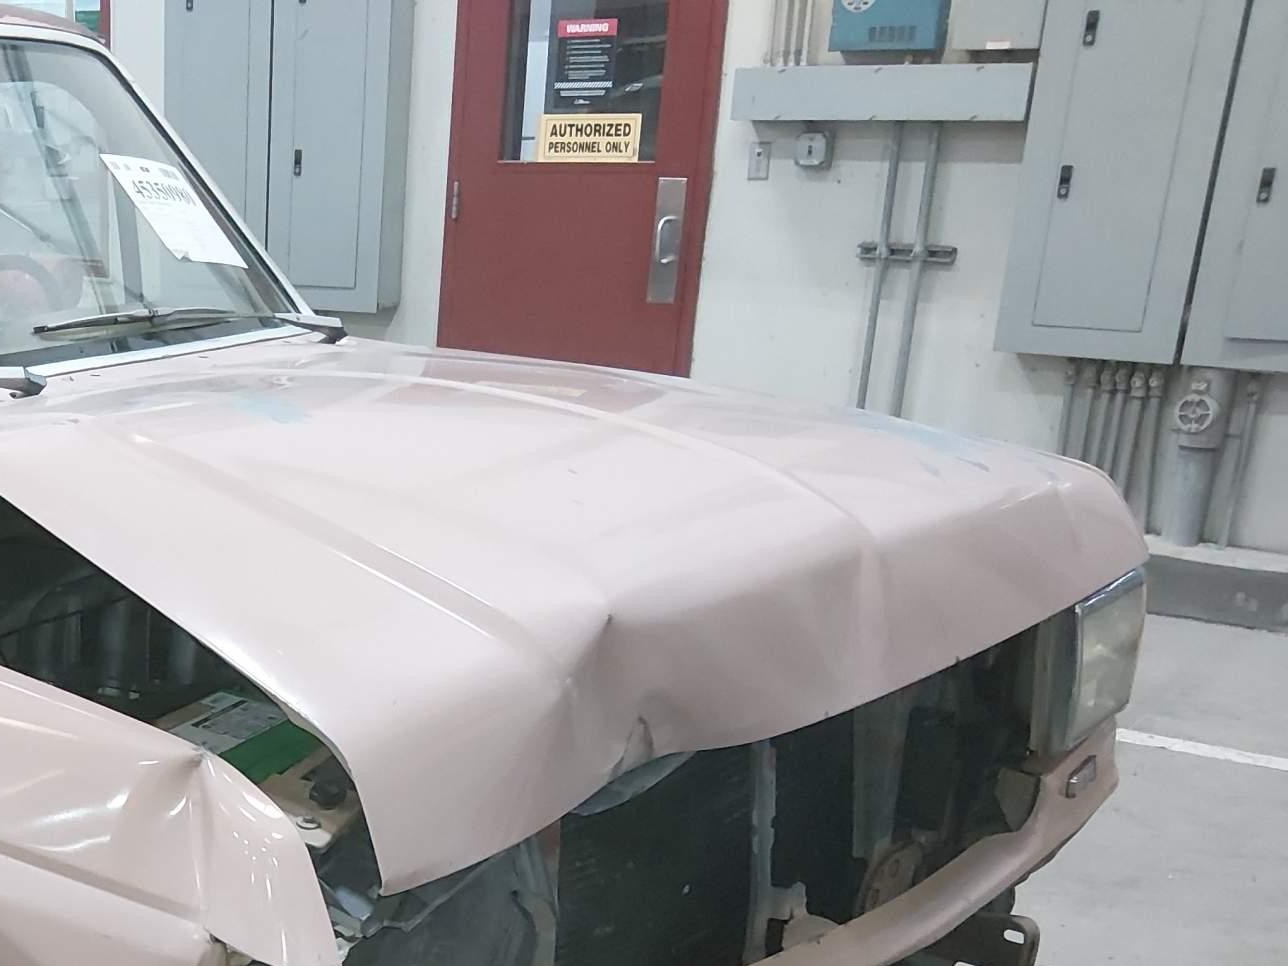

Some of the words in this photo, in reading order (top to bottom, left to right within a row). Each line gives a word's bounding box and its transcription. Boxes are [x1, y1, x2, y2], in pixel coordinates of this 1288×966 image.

[566, 22, 610, 34] WARNING
[549, 123, 632, 138] AUTHORIZED
[548, 141, 602, 153] PERSONNEL
[605, 141, 631, 153] ONLY
